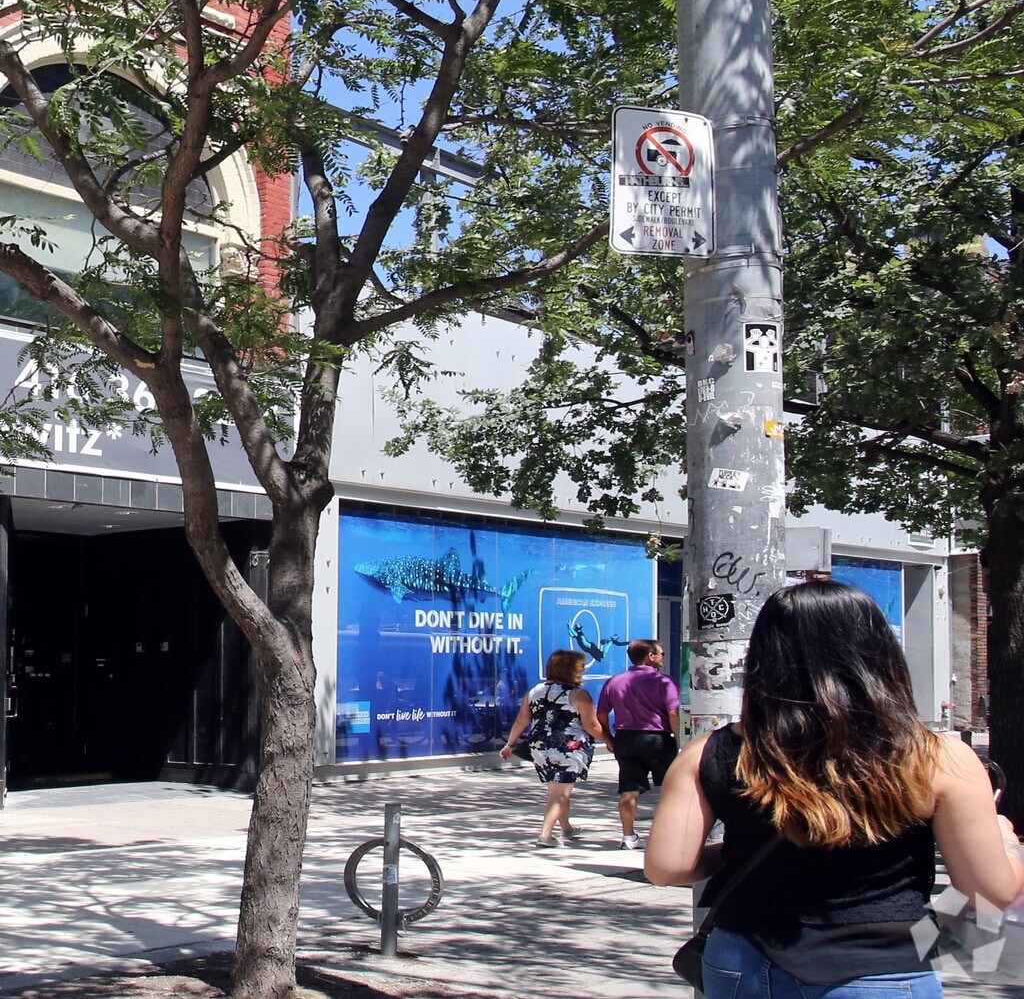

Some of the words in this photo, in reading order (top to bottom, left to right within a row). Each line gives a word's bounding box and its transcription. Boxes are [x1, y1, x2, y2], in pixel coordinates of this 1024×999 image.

[648, 190, 682, 203] EXCEPT
[626, 202, 638, 213] BY
[643, 203, 665, 215] CITY
[669, 205, 701, 218] PERMIT
[643, 225, 684, 238] REMOVAL
[651, 238, 676, 251] ZONE
[415, 609, 464, 629] DON'T
[469, 611, 505, 630] DIVE
[508, 613, 523, 630] IN
[430, 635, 502, 653] WITHOUT
[506, 637, 524, 654] IT.
[376, 713, 395, 721] DON'T
[396, 709, 411, 722] live
[411, 707, 425, 722] life
[426, 710, 451, 718] WITHOUT
